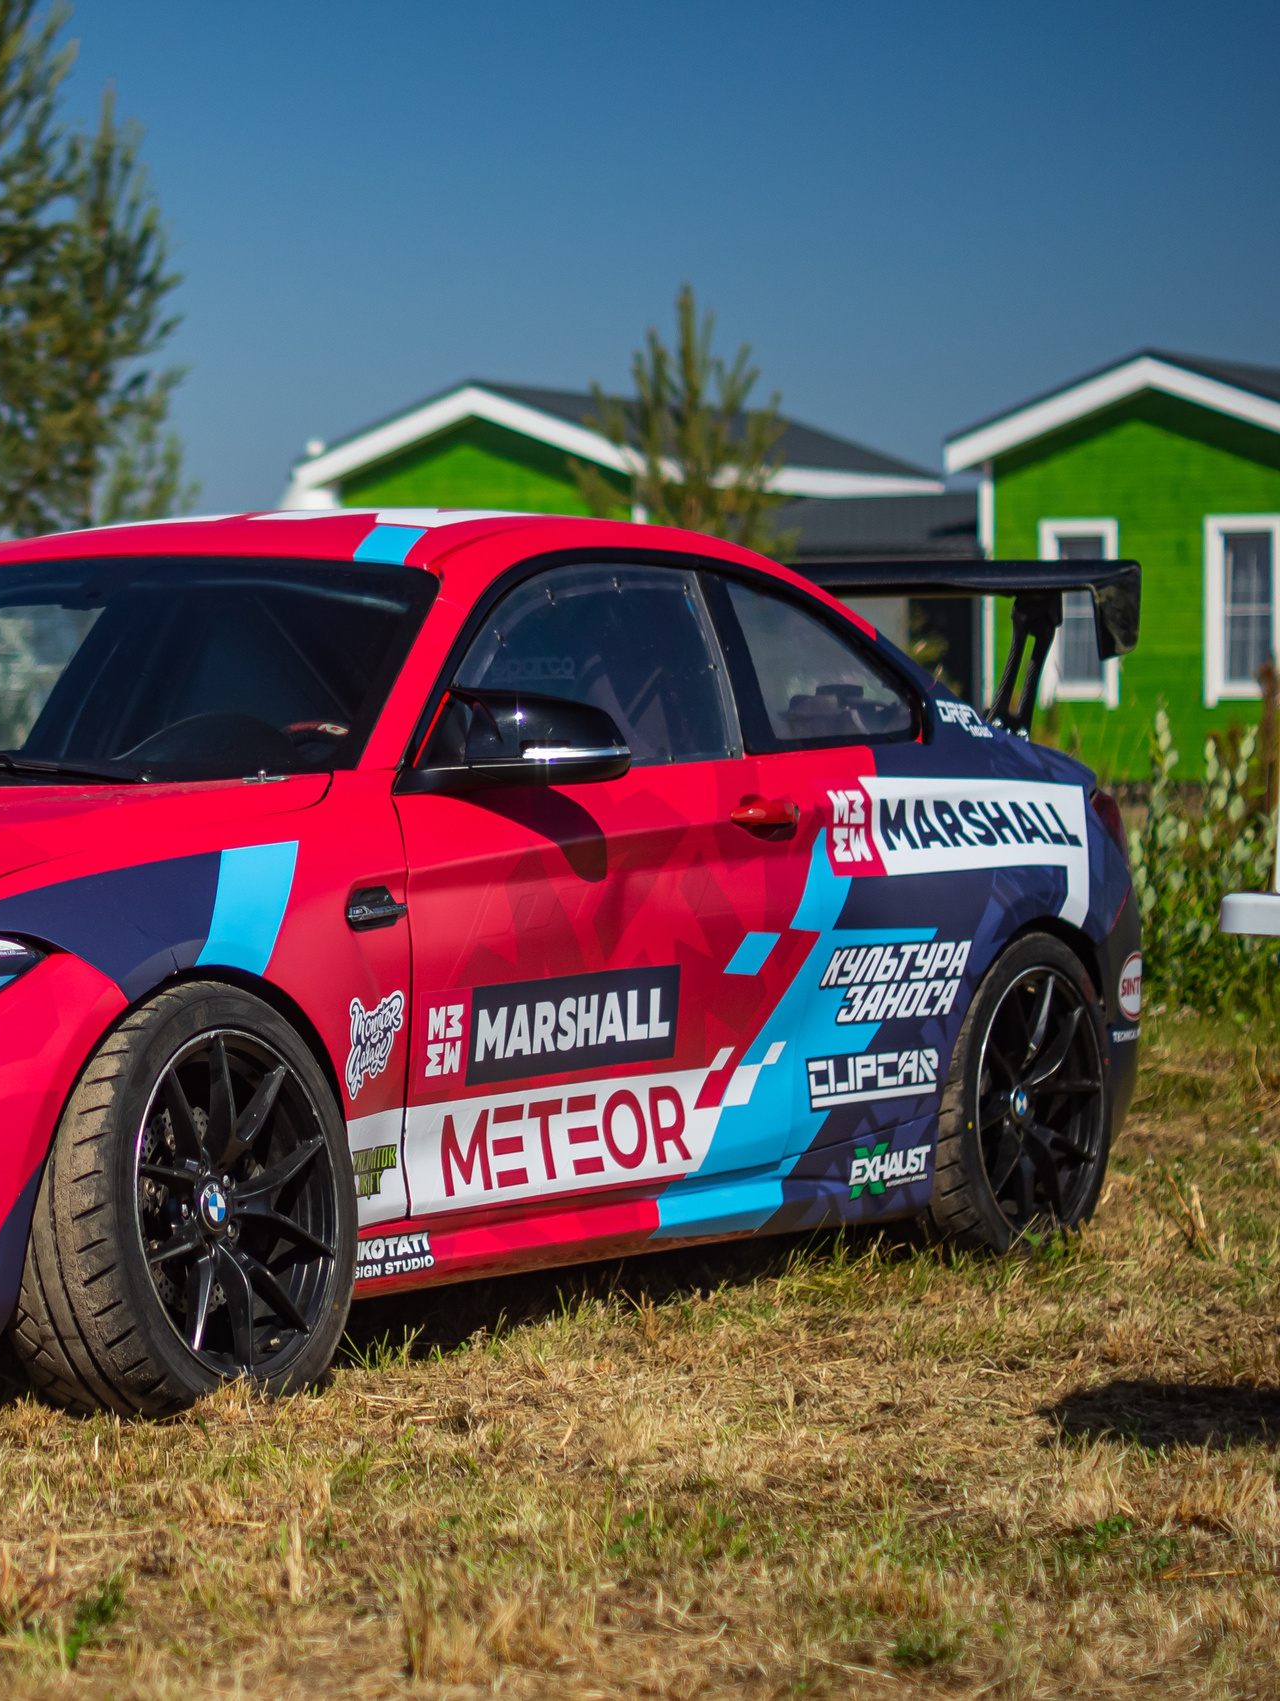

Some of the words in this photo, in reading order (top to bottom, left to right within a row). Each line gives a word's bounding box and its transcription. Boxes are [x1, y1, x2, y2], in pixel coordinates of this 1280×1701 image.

[880, 798, 1083, 851] MARSHALL
[820, 940, 972, 987] КУЛЬТУРА
[836, 979, 961, 1023] ЗАНОСА
[1121, 976, 1142, 997] SINT
[474, 987, 670, 1063] MARSHALL
[808, 1048, 939, 1096] CLIPCAR
[440, 1085, 692, 1197] METEOR
[848, 1144, 932, 1186] EXHAUST
[355, 1263, 382, 1279] SIGN
[385, 1254, 435, 1275] STUDIO
[357, 1231, 431, 1261] IKOTATI
